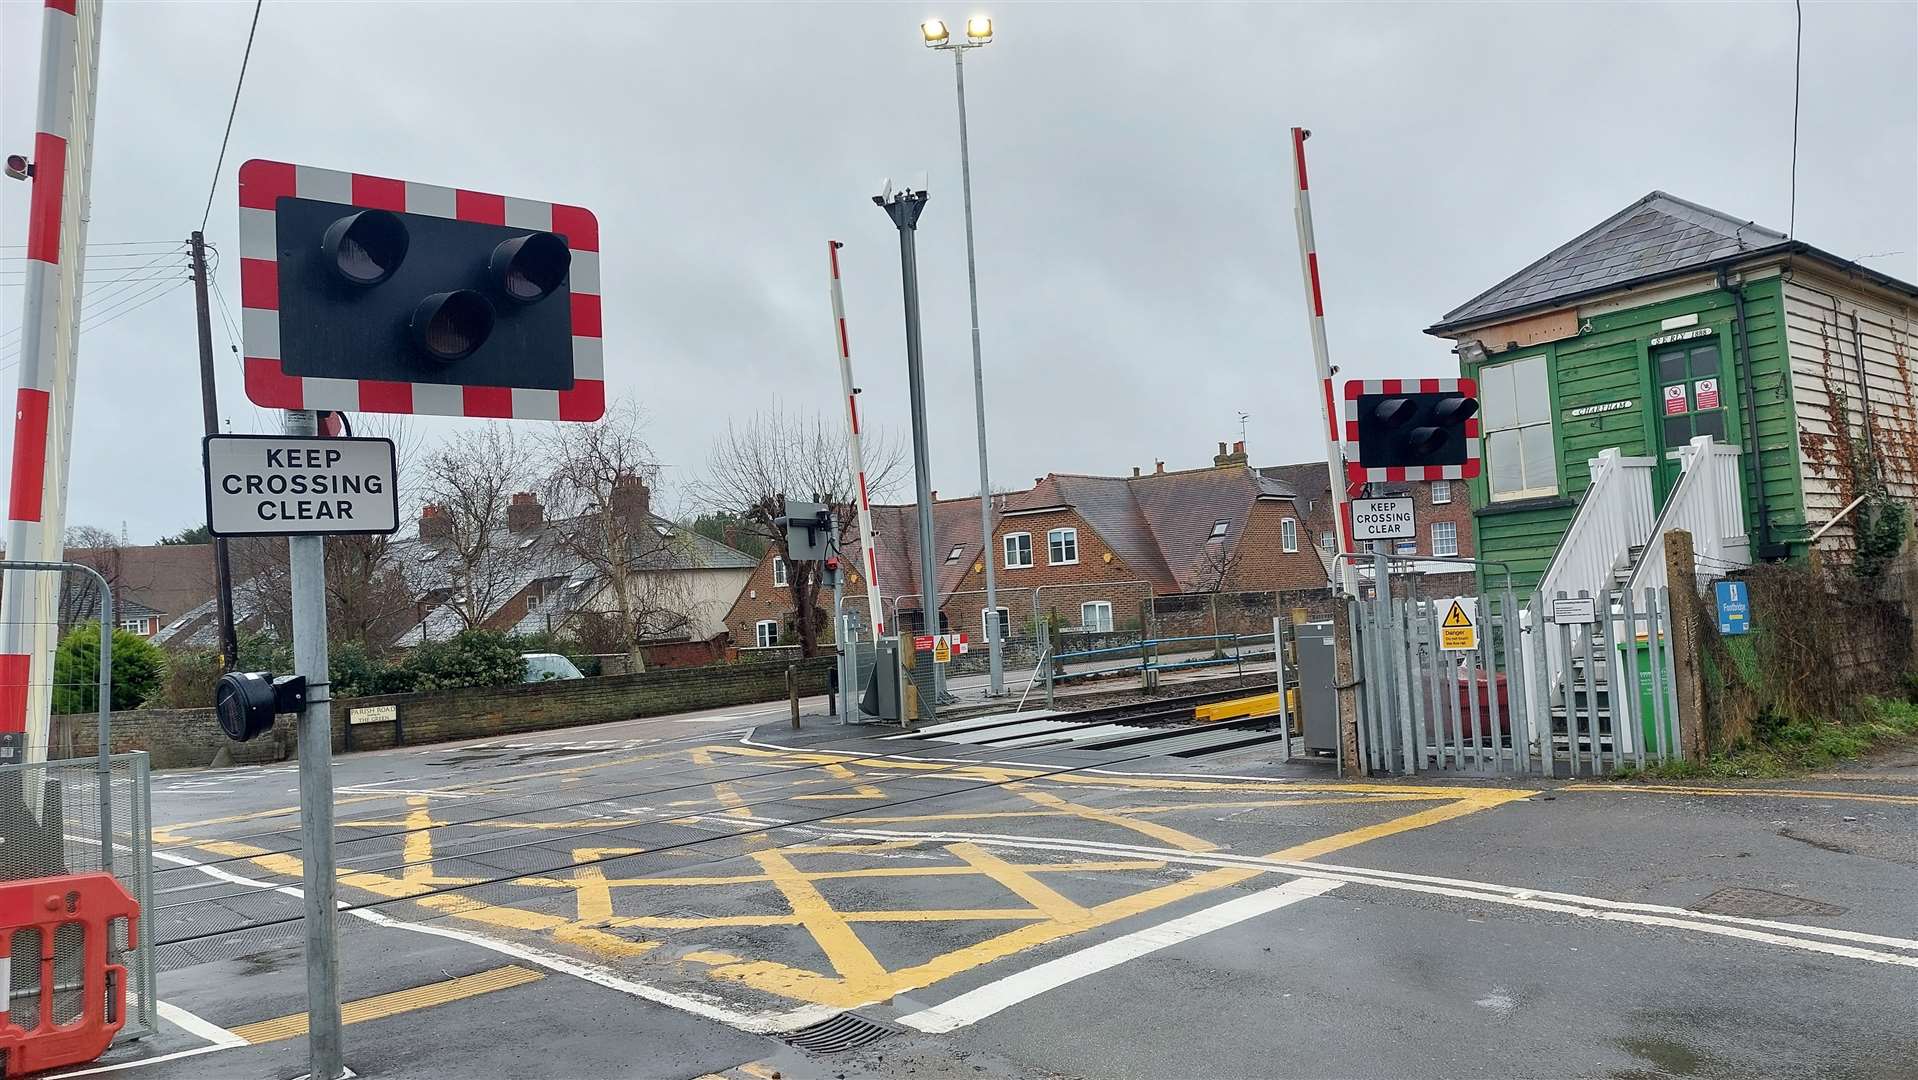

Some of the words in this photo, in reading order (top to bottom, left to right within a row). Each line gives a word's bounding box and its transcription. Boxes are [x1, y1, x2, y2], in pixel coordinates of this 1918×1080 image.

[267, 449, 342, 468] KEEP
[222, 474, 383, 494] CROSSING
[257, 500, 354, 520] CLEAR
[1370, 502, 1396, 512] KEEP
[1356, 512, 1411, 524] CROSSING
[1368, 524, 1401, 534] CLEAR
